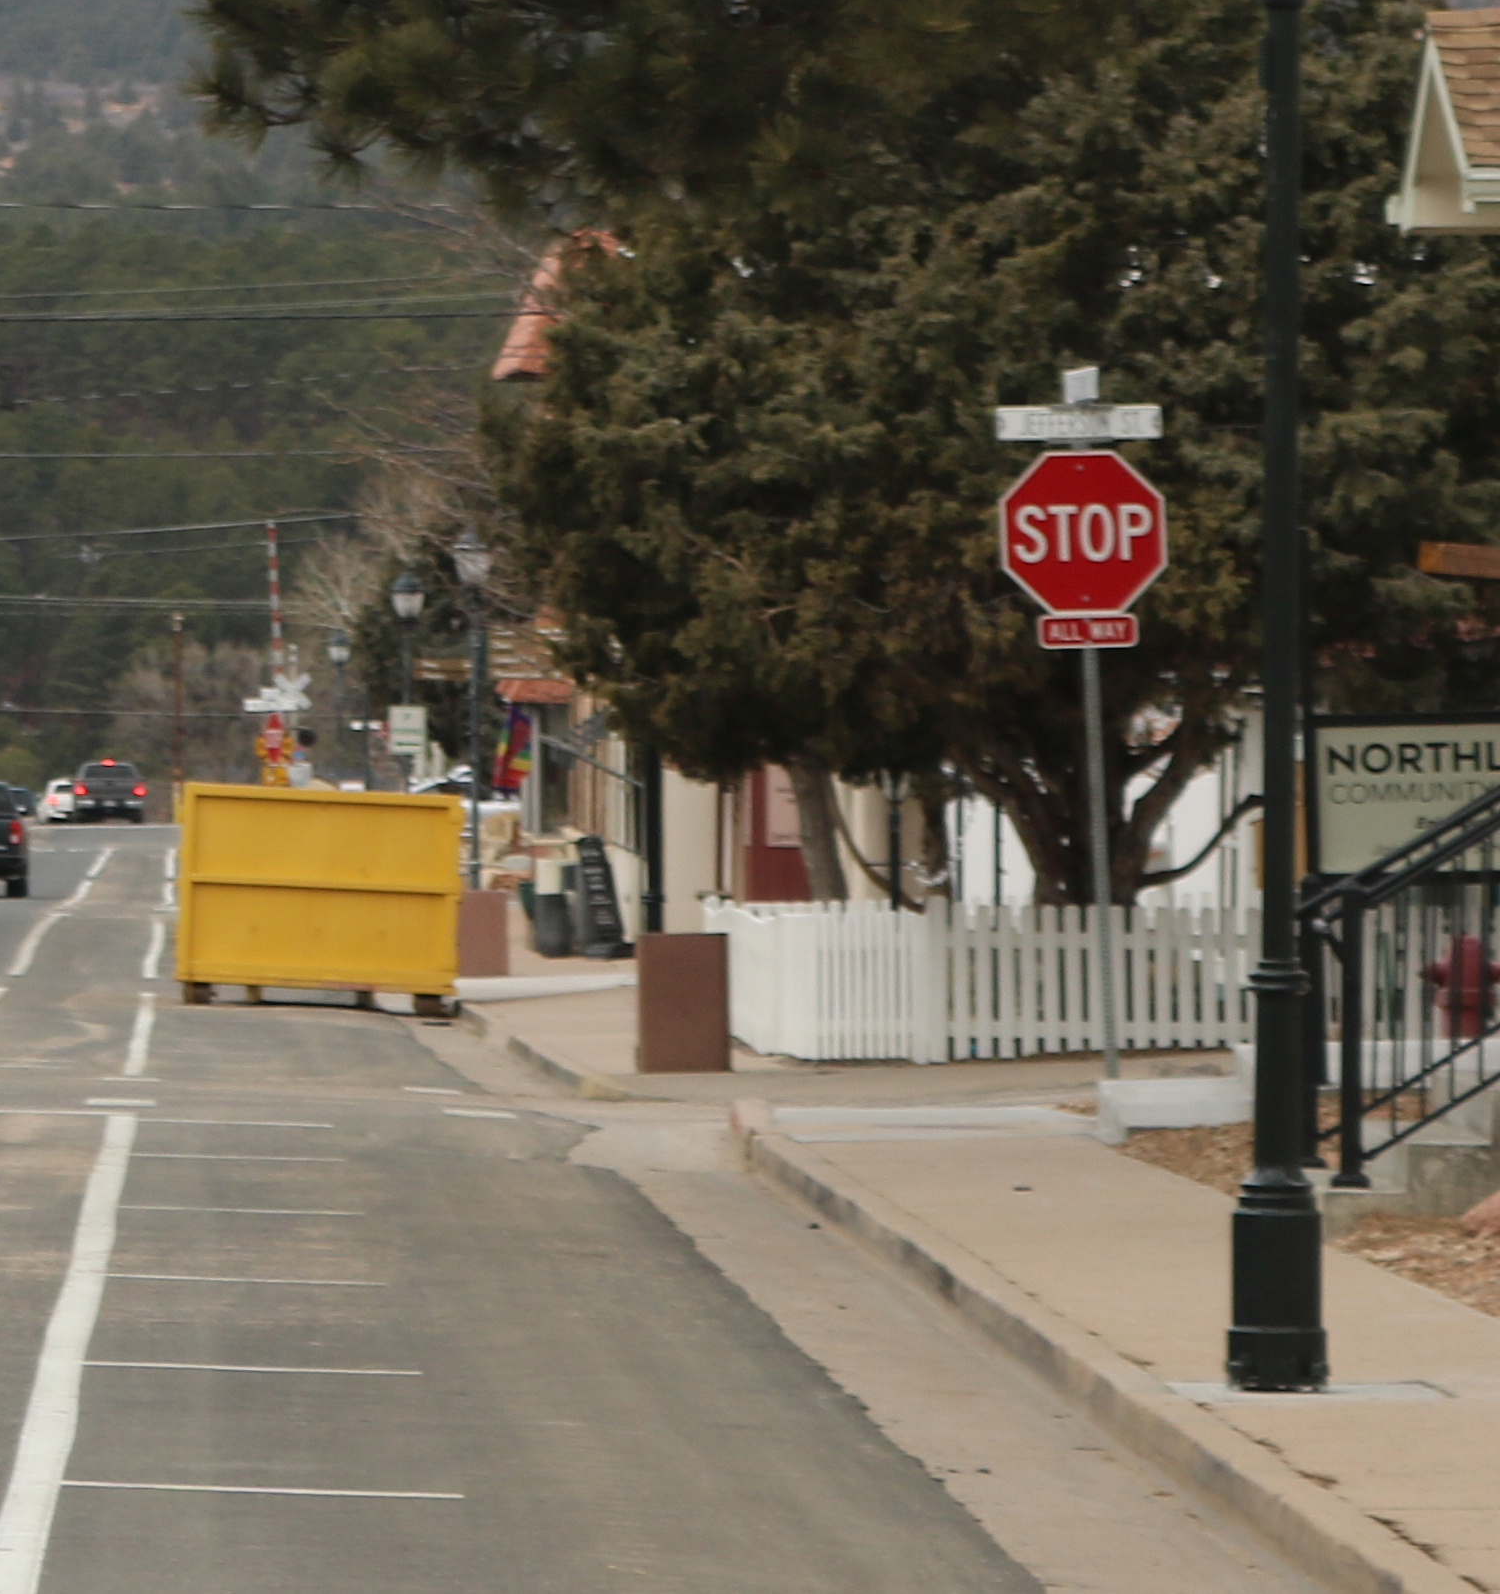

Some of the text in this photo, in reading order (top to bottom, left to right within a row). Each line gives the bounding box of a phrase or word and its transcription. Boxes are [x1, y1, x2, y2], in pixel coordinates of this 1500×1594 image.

[1013, 503, 1154, 563] STOP
[1049, 622, 1128, 641] ALL WAY
